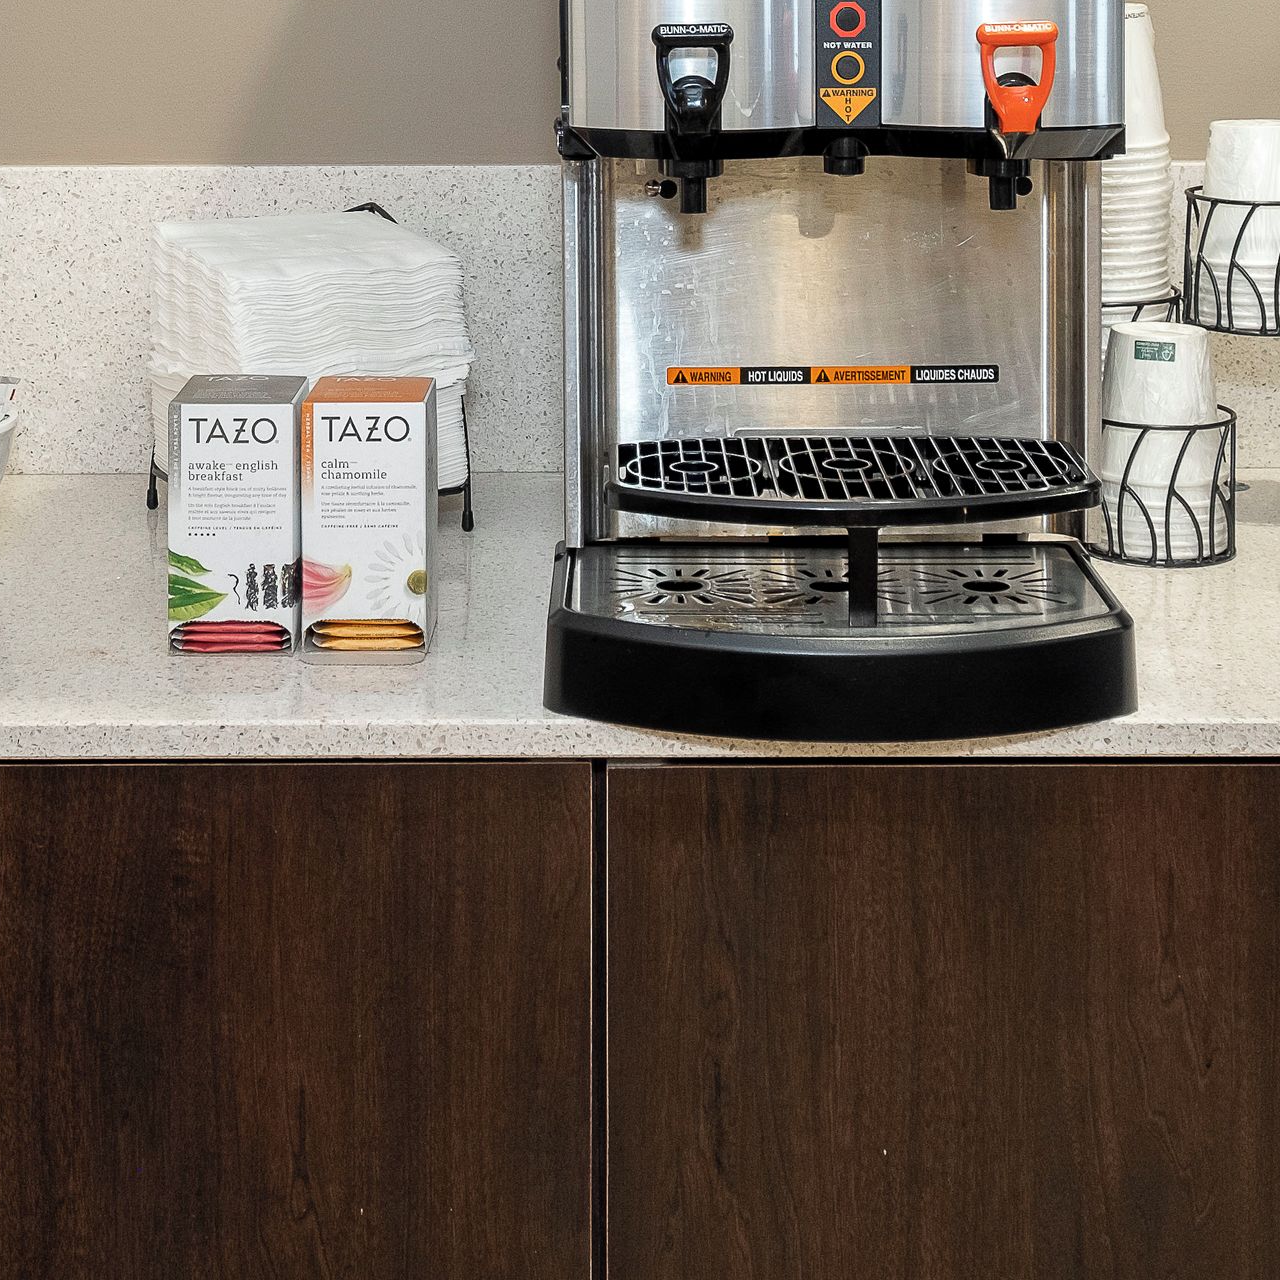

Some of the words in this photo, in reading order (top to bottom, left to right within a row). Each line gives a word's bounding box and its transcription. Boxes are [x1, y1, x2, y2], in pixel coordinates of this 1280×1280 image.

[659, 24, 728, 35] BUNN-O-MATIC
[984, 23, 1052, 33] BUNN-O-MATIC
[843, 41, 873, 49] WATER
[831, 89, 874, 97] WARNING
[690, 371, 732, 383] WARNING
[748, 371, 768, 382] HOT
[769, 370, 803, 382] LIQUIDS
[833, 370, 906, 382] AVERTISSEMENT
[916, 369, 954, 381] LIQUIDES
[955, 368, 995, 380] CHAUDS
[188, 417, 278, 445] TAZO
[321, 416, 410, 442] TAZO
[235, 460, 278, 473] english
[188, 471, 244, 481] breakfast
[321, 469, 387, 480] chamomile
